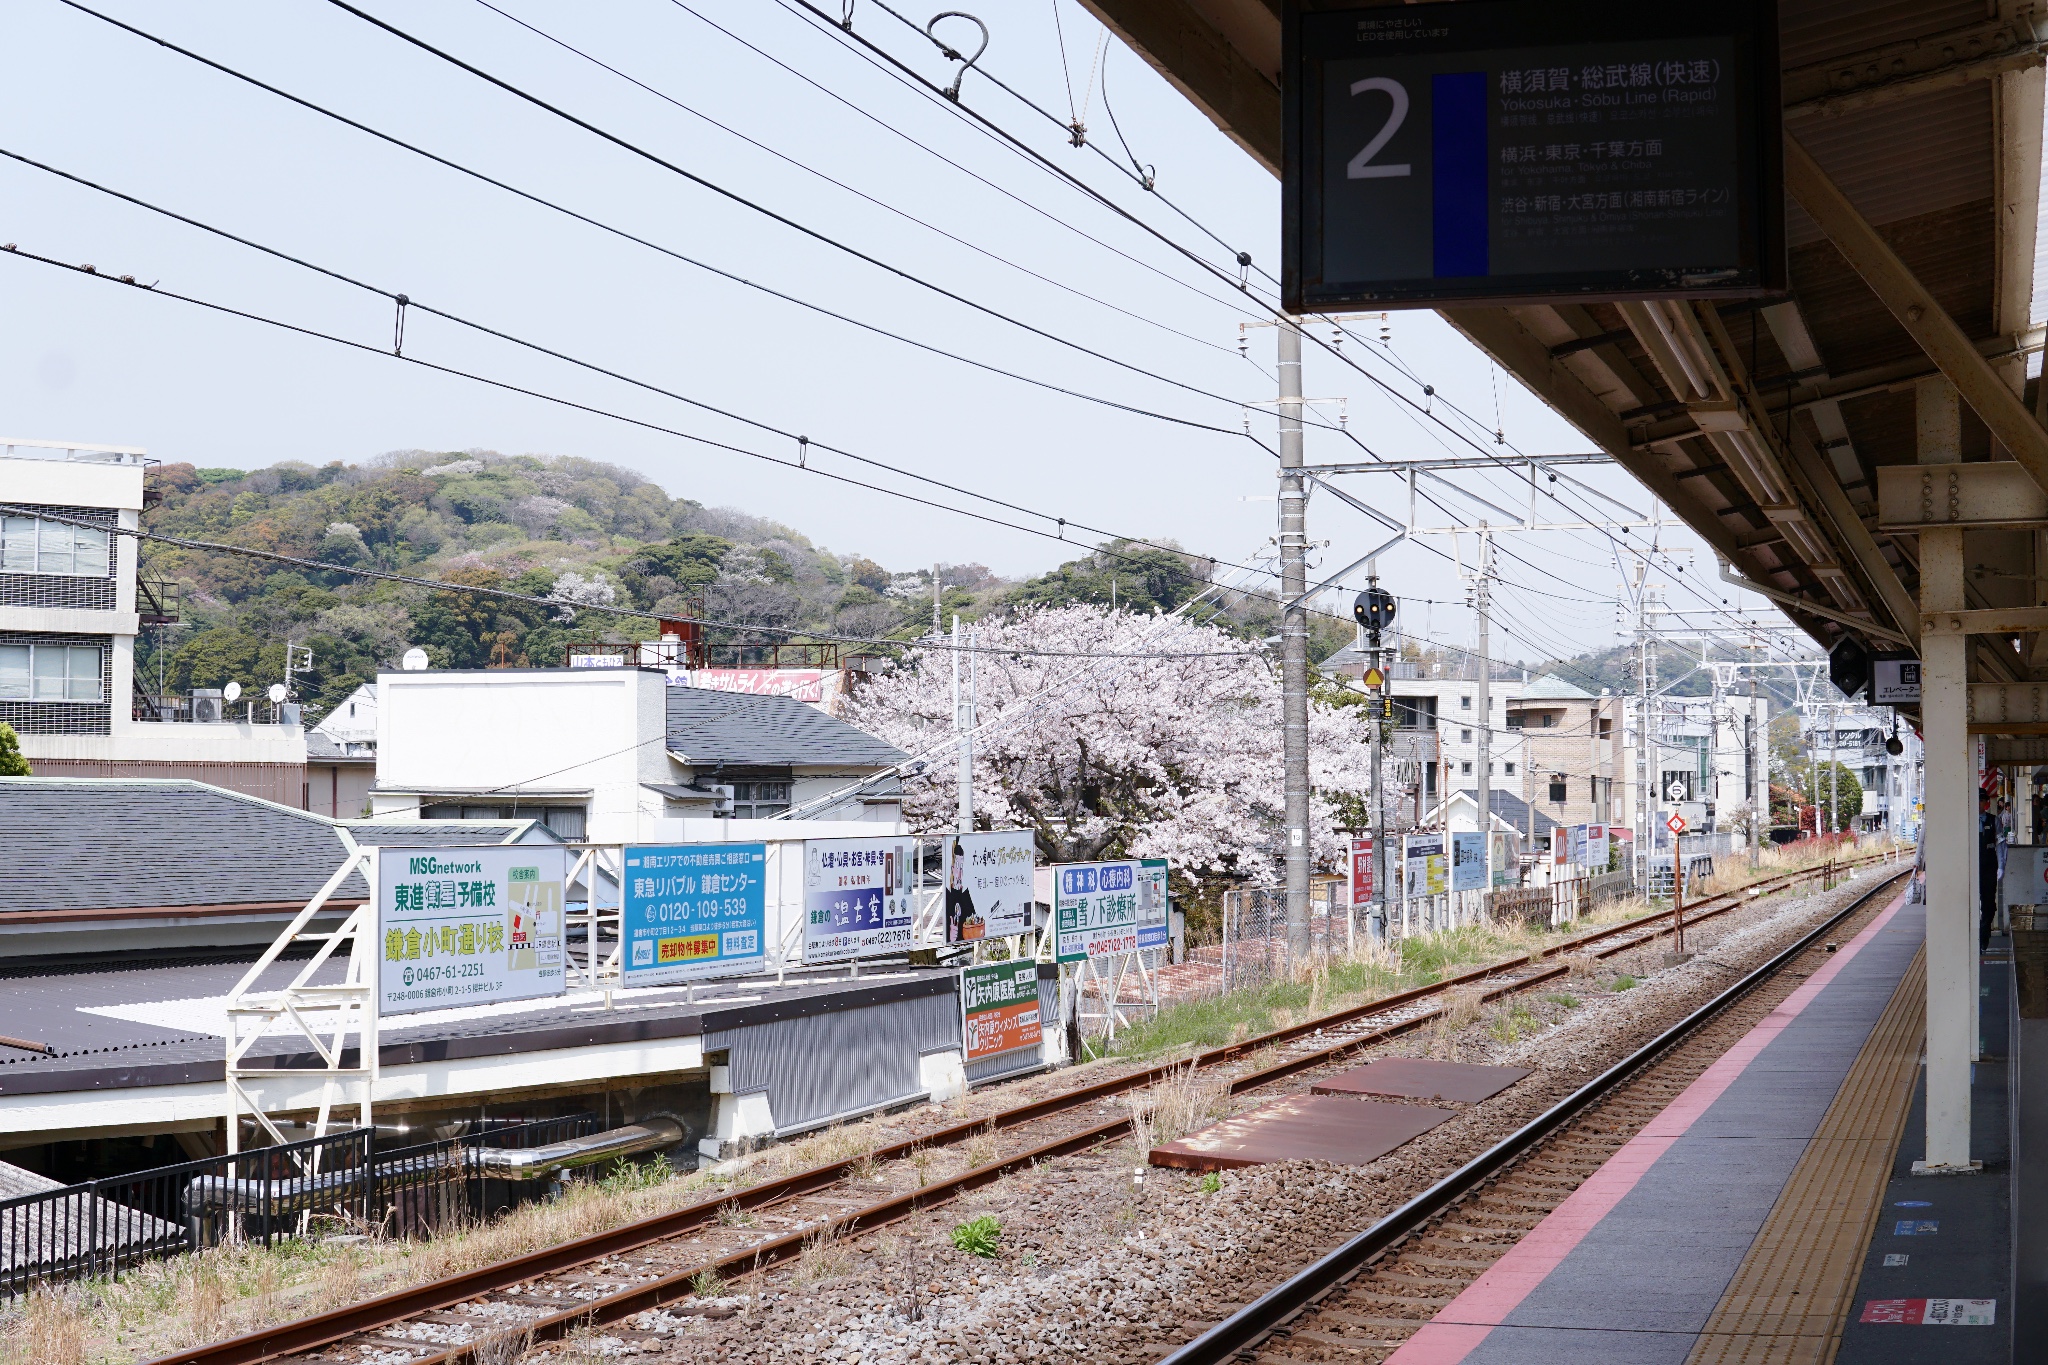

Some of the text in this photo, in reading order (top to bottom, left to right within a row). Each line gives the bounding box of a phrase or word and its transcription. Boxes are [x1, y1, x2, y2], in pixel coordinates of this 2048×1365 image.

[1356, 28, 1450, 42] LEDを使用しています
[1357, 18, 1422, 30] 環境にやさしい
[1499, 58, 1720, 95] 横須賀・総武線(快速)
[1625, 90, 1656, 103] Line
[1662, 85, 1717, 104] (Rapid)
[1346, 76, 1412, 180] 2
[1500, 139, 1662, 164] 横浜・東京・千葉方面
[1500, 167, 1510, 176] for
[1609, 162, 1618, 171] &
[1621, 160, 1652, 170] Chiba
[1500, 187, 1730, 213] 渋谷・新宿・大宮方面(湘南新宿ライン)
[572, 656, 623, 667] 山本ともひろ
[699, 672, 758, 694] 若きサムライ
[410, 857, 482, 875] MSGnetwork
[512, 869, 536, 881] 校舎案内
[634, 873, 757, 899] 東急リバブル 鎌倉センター
[1065, 868, 1131, 893] 精神科 心療内科
[394, 880, 496, 912] 東進衛星予備校
[659, 898, 747, 922] 0120-109-539
[810, 910, 831, 925] 鎌倉の
[1078, 893, 1136, 927] 雪ノ下診療所
[385, 921, 505, 962] 鎌倉小町通り校
[661, 939, 716, 959] 売却物件募集中
[725, 935, 755, 952] 無料査定
[417, 963, 484, 982] 0467-61-2251
[977, 978, 1015, 1006] 矢内原医院
[979, 1015, 1019, 1037] 矢内原ウィメンズ
[979, 1034, 1003, 1052] クリニック
